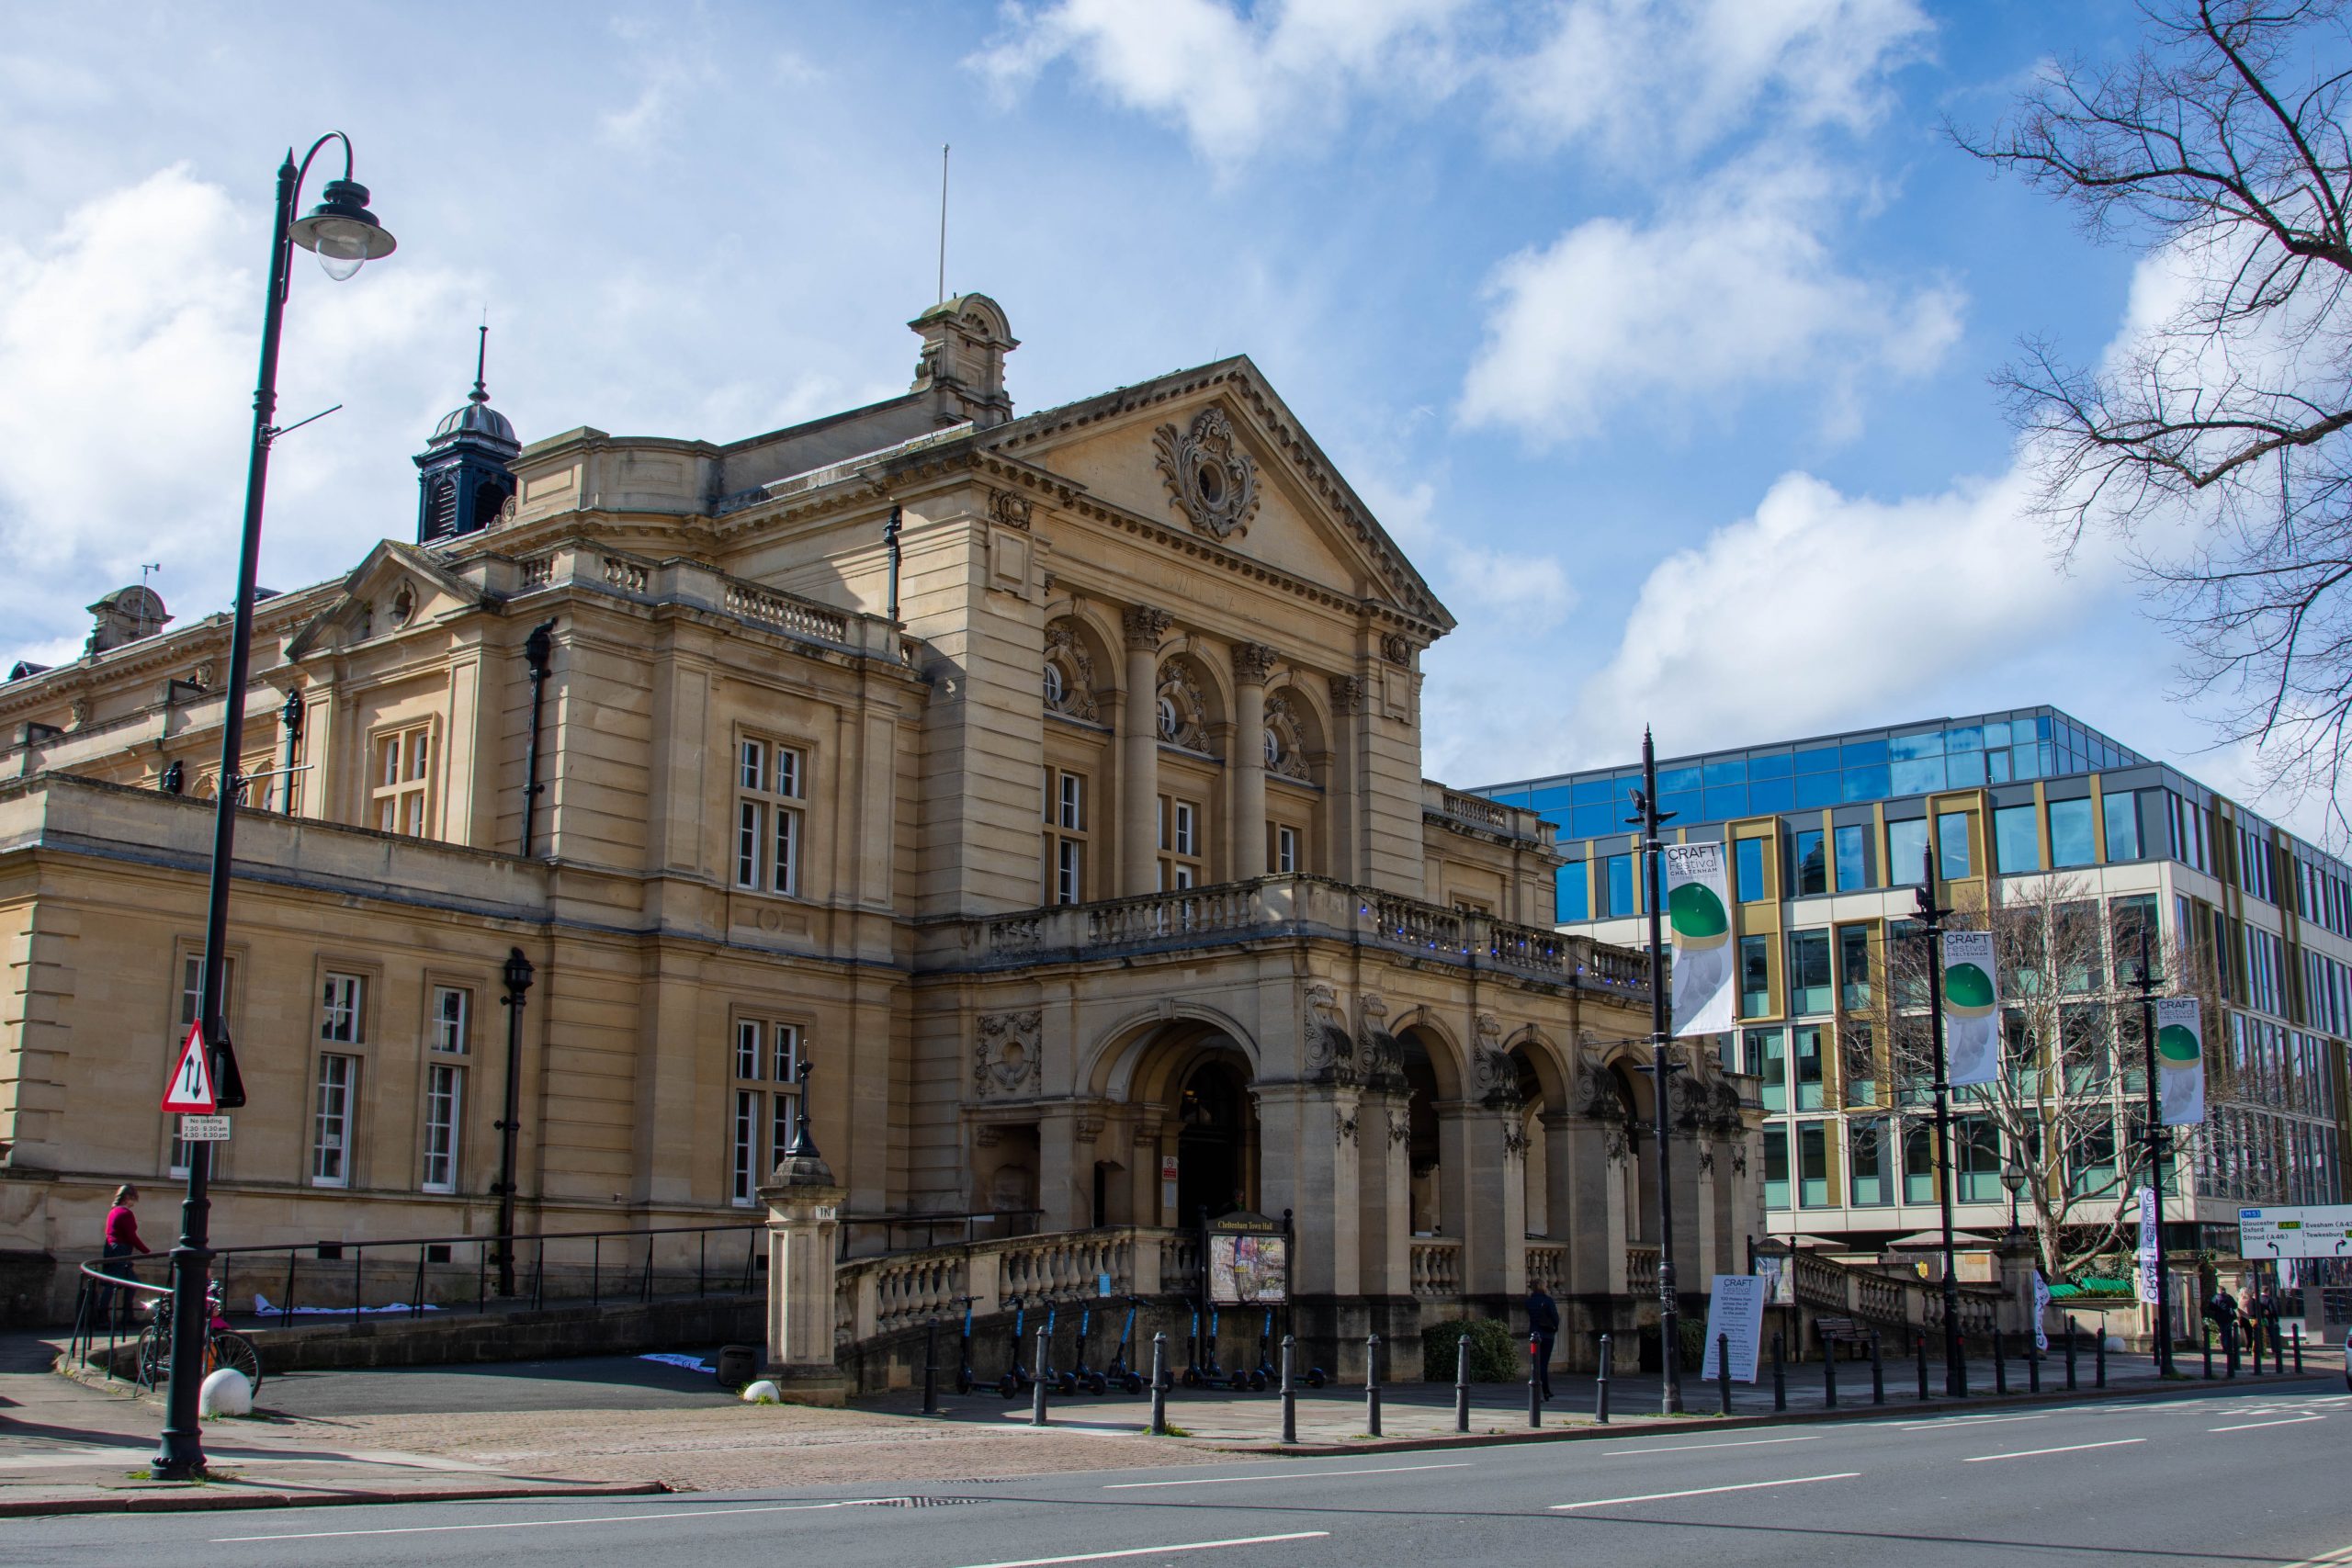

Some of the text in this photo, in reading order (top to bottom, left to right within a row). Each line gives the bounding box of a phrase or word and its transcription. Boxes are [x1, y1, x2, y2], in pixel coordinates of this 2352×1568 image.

[1668, 845, 1716, 860] CRAFT
[1668, 857, 1717, 871] Festival
[1670, 867, 1717, 875] CHELTENHAM
[1946, 934, 1989, 943] CRAFT
[1946, 943, 1987, 952] Festival
[2159, 1000, 2196, 1010] CRAFT
[1217, 1221, 1248, 1229] Cheltenham
[1262, 1222, 1273, 1230] Hall
[1724, 1279, 1753, 1287] CRAFT
